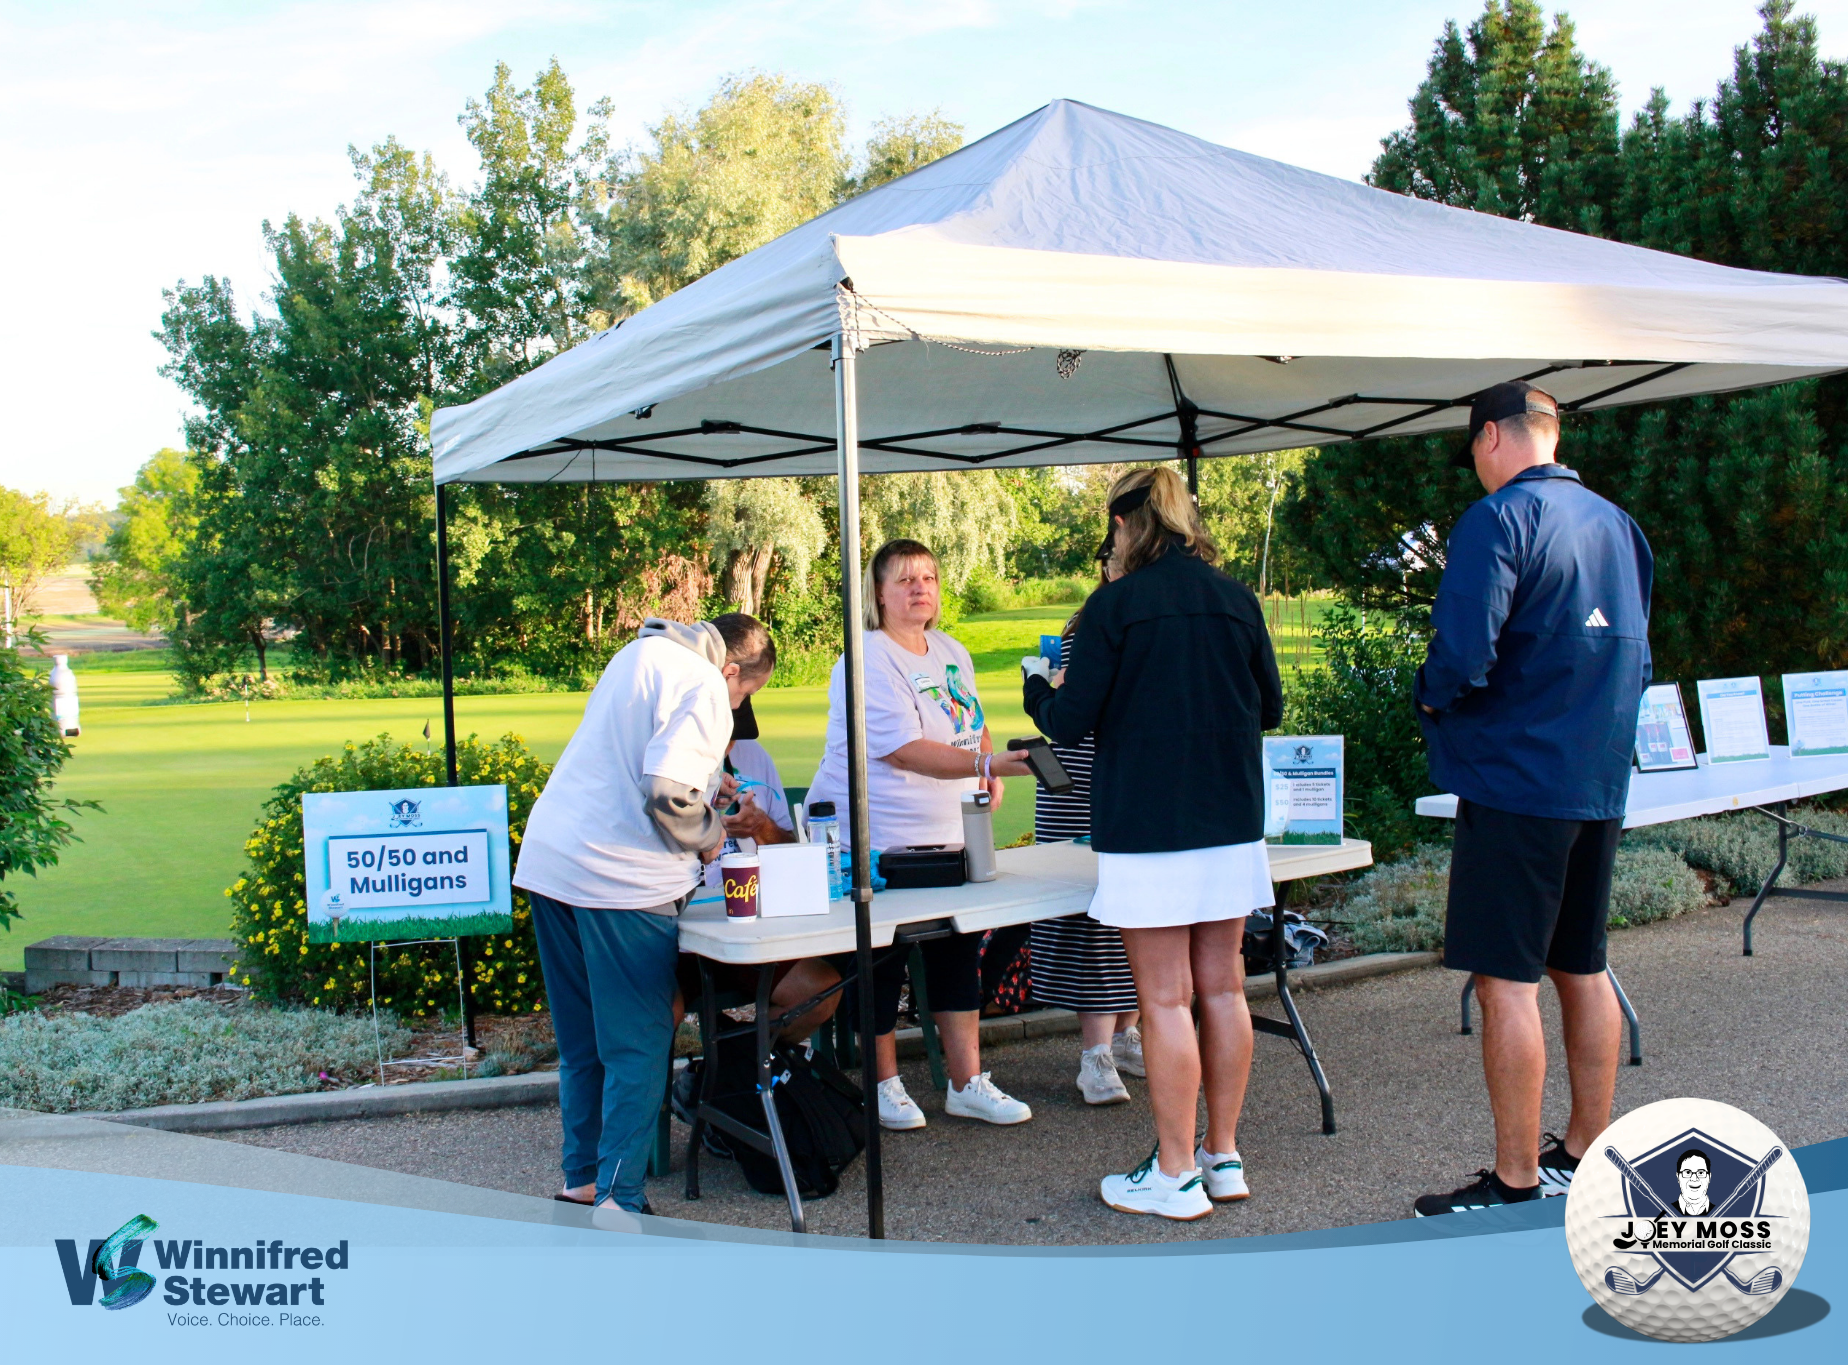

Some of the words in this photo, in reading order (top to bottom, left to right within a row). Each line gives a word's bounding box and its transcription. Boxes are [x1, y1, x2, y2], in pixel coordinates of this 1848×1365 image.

[347, 845, 417, 872] 50/50
[422, 845, 468, 865] and
[350, 873, 468, 897] Mulligans
[724, 875, 758, 903] Café
